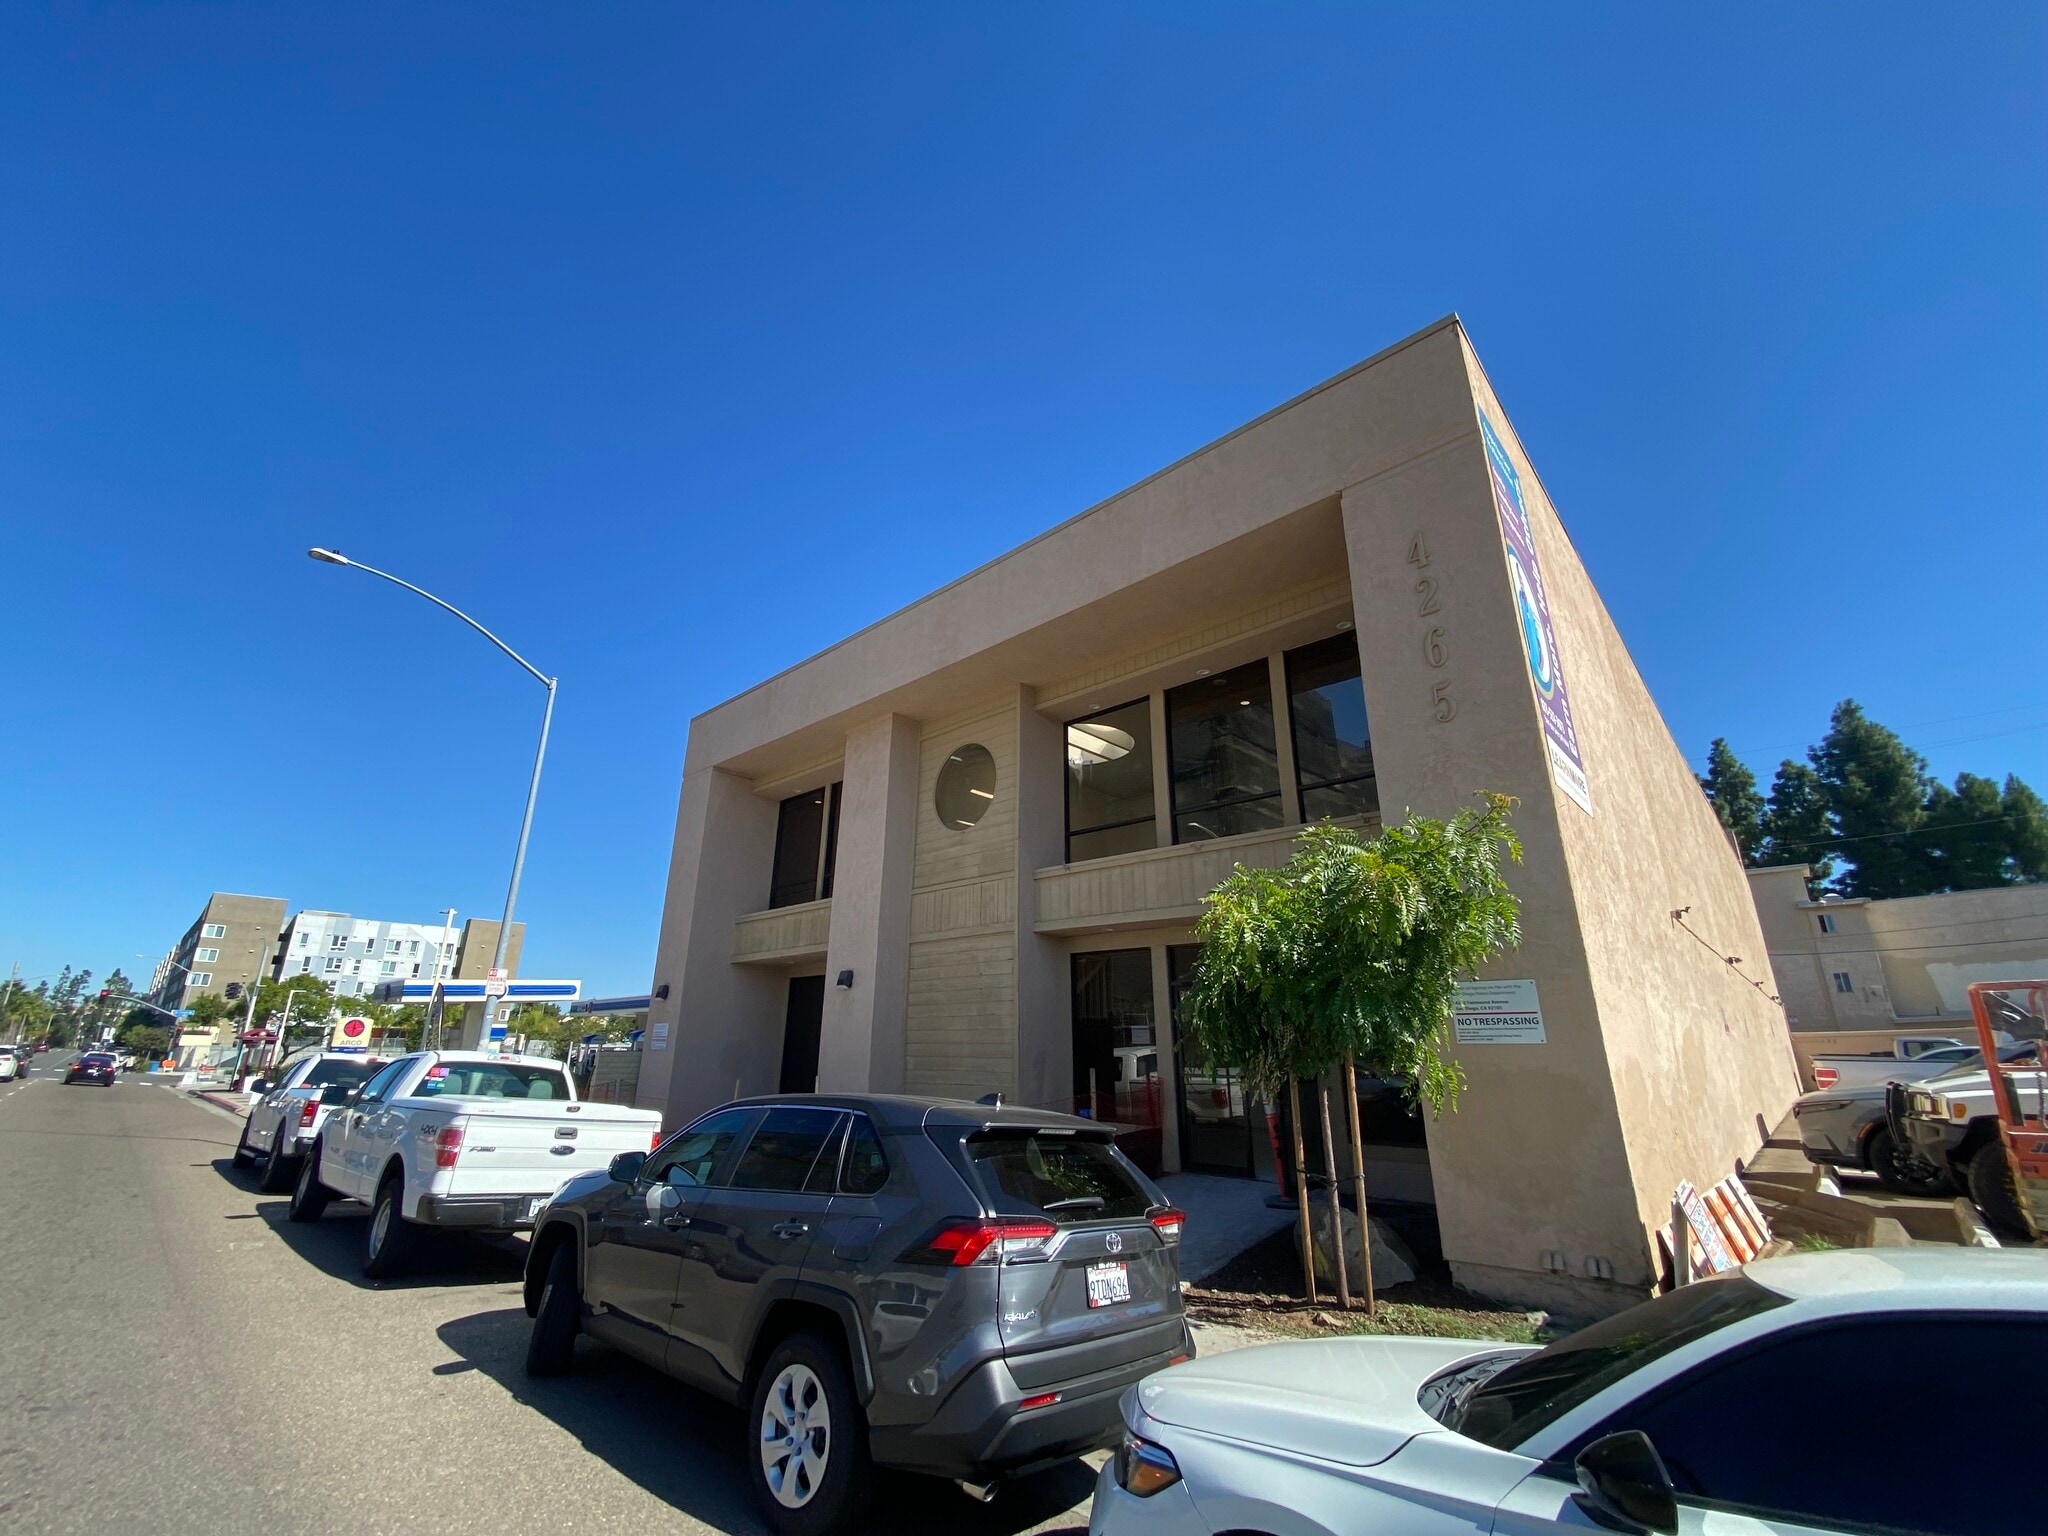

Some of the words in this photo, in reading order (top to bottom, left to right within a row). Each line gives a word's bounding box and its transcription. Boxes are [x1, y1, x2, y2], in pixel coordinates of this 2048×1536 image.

[1407, 528, 1459, 724] 4265
[1457, 1018, 1472, 1026] NO
[1473, 1016, 1540, 1026] TRESPASSING
[1090, 1276, 1128, 1300] 9TDN696
